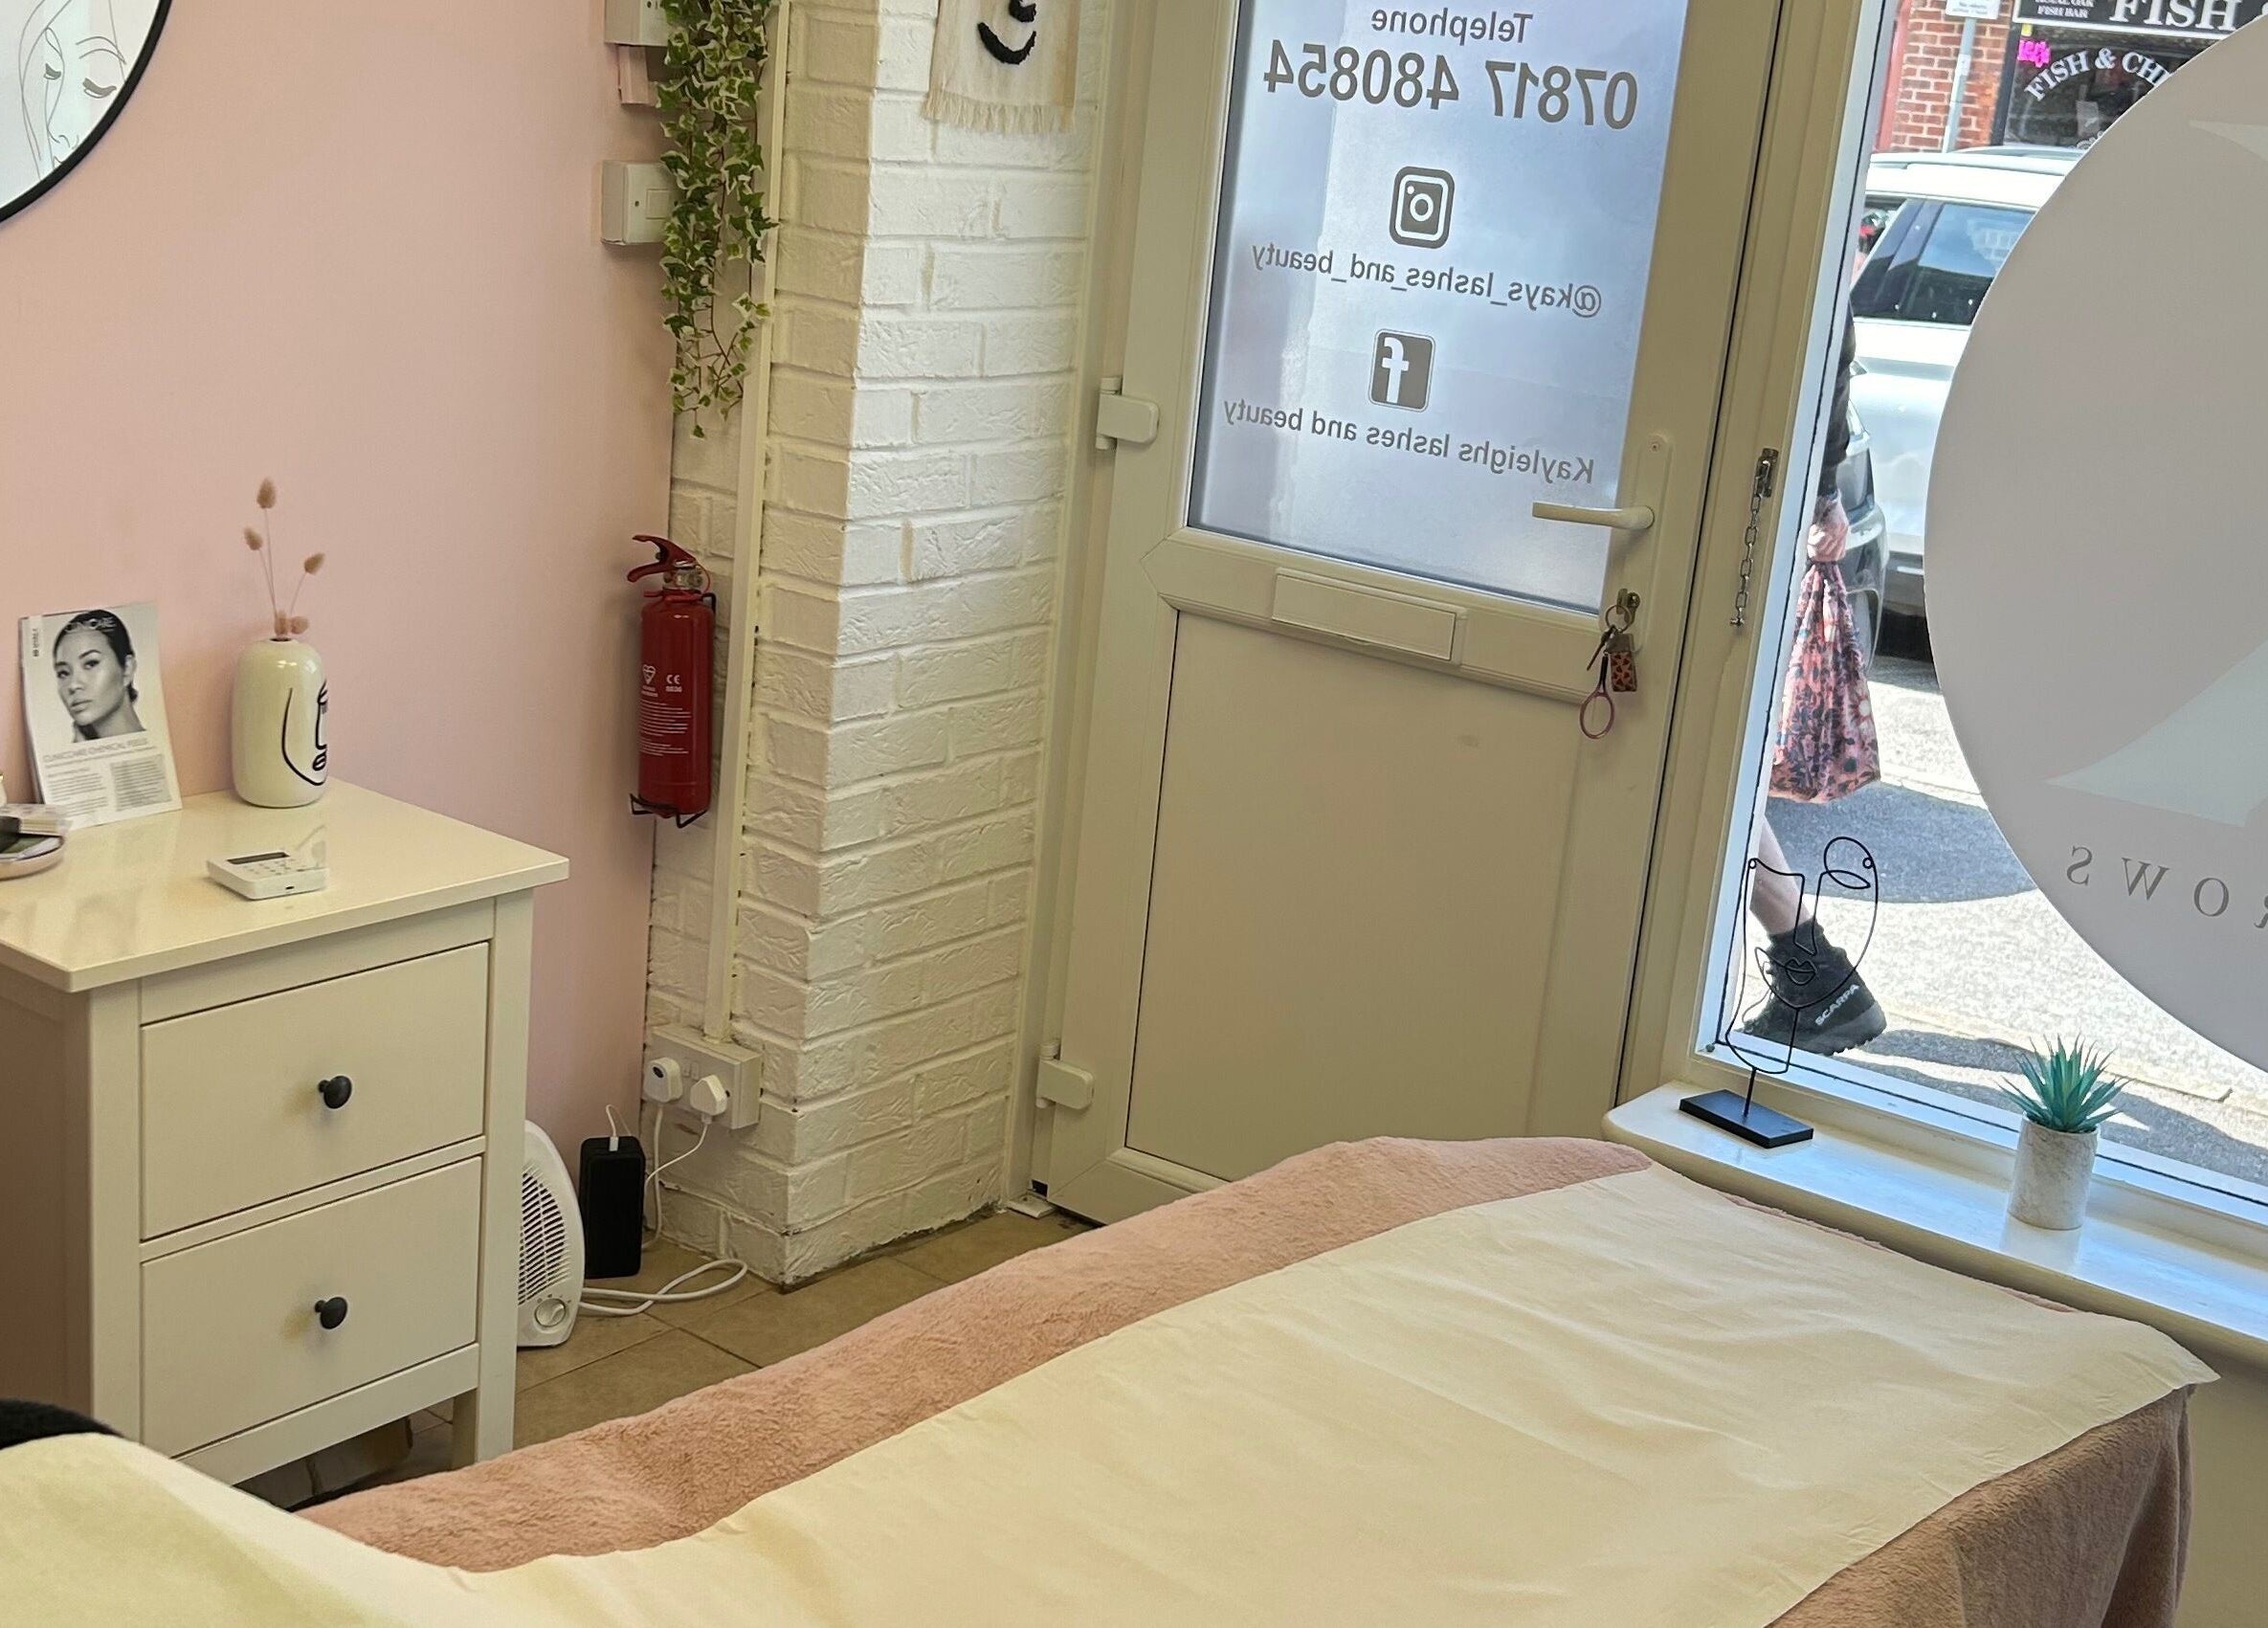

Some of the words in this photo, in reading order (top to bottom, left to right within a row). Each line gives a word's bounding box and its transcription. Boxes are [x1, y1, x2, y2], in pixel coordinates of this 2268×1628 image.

[2036, 5, 2064, 16] FISH
[2064, 8, 2089, 19] BAR
[2109, 0, 2242, 32] FISH
[2024, 50, 2090, 101] FISH
[2094, 47, 2117, 70] &
[1814, 984, 1860, 1026] SCARPA
